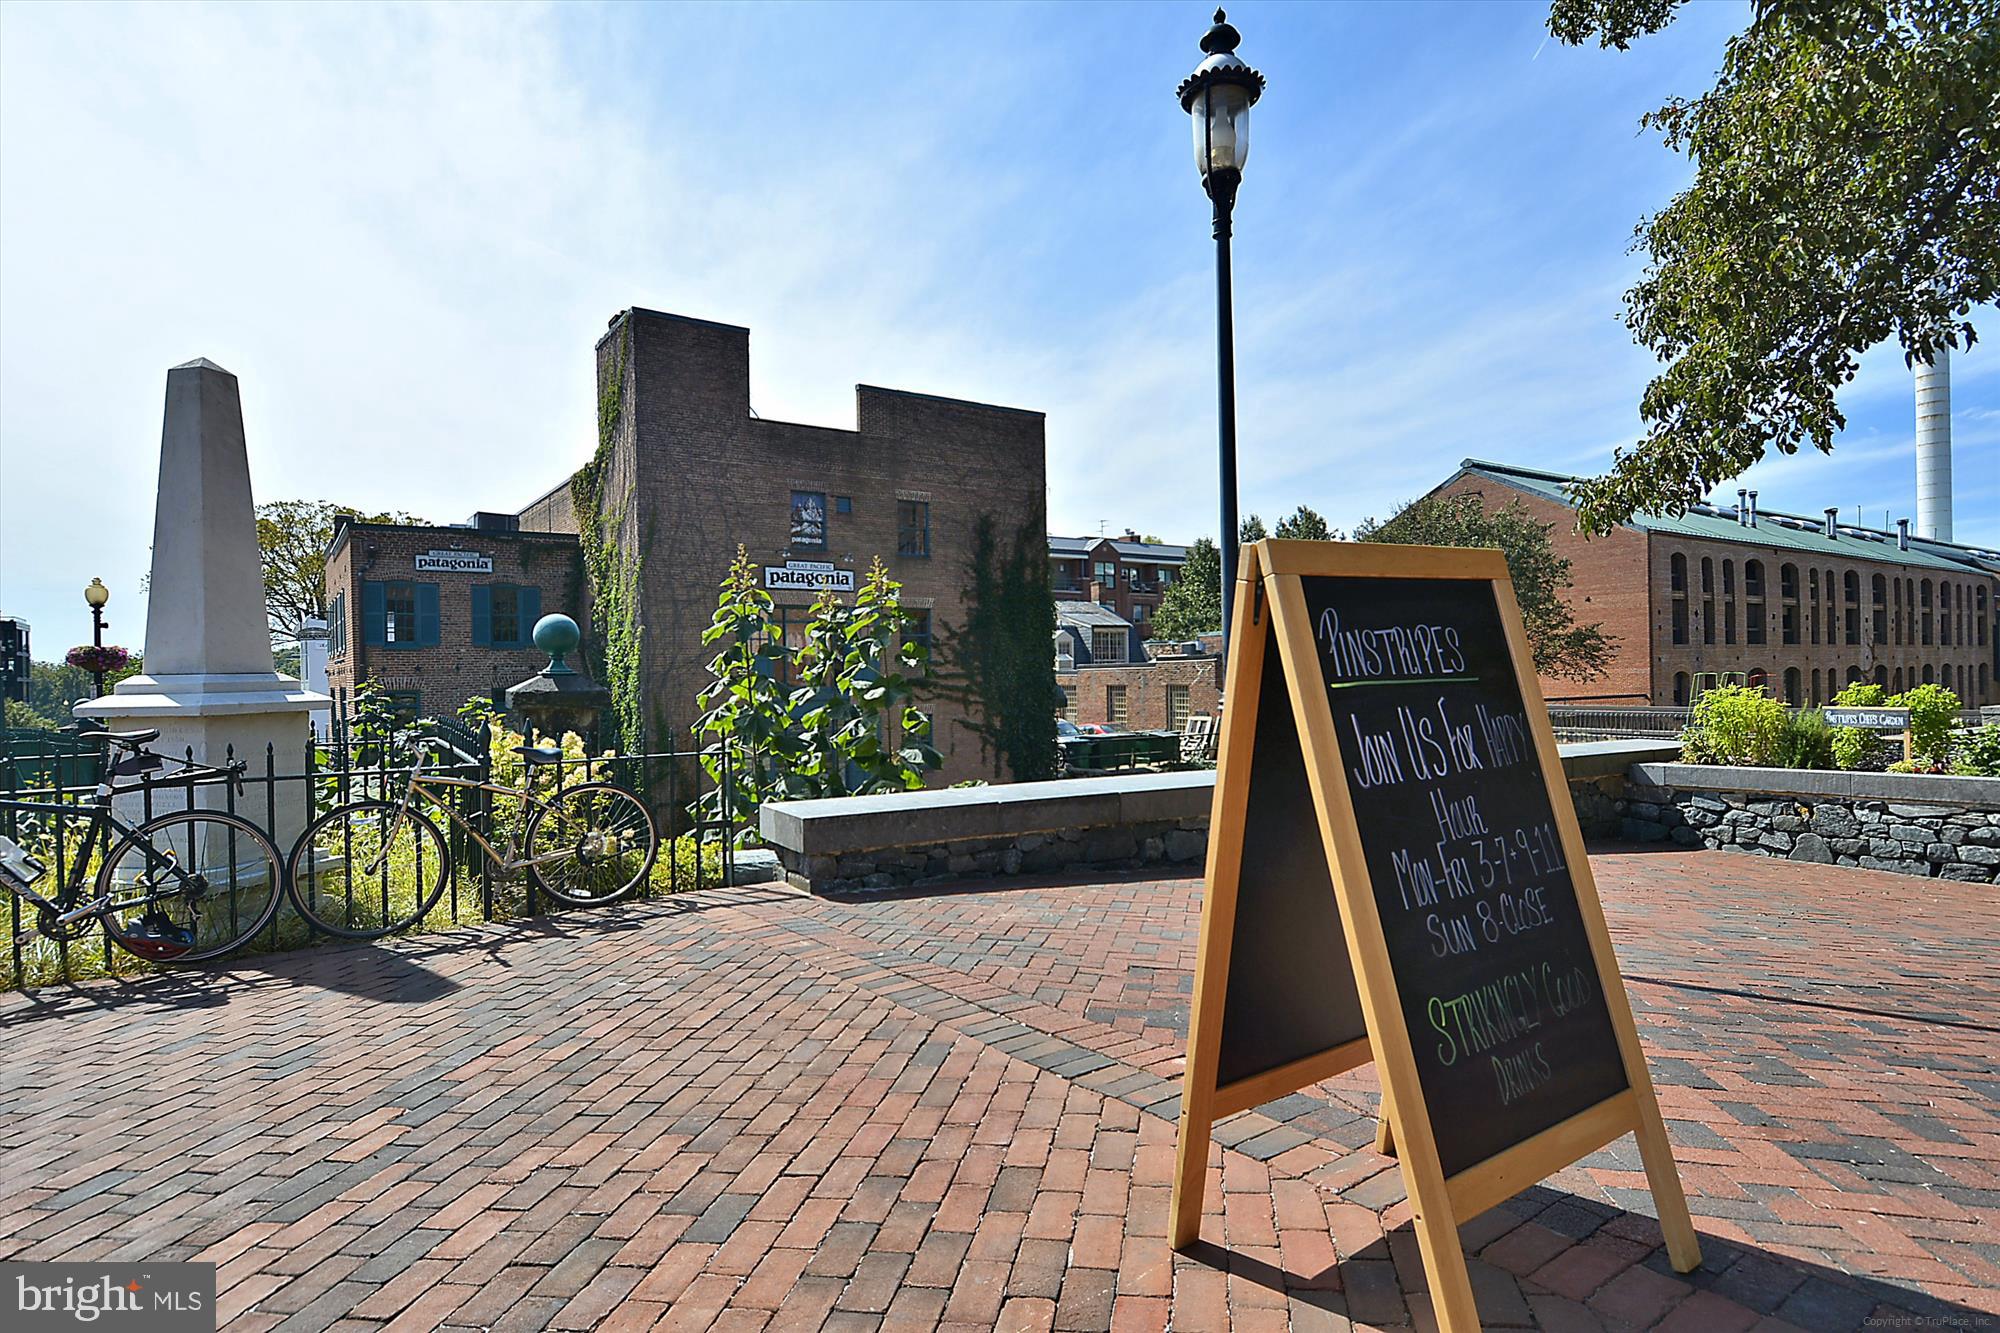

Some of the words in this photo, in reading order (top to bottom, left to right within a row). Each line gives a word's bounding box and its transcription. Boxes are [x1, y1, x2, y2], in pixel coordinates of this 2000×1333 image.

[418, 558, 488, 570] patagonia
[769, 570, 850, 587] patagonia
[1319, 607, 1467, 678] PINSTRIPES
[1350, 713, 1404, 789] JOIN
[1397, 706, 1447, 781] US
[1437, 697, 1484, 774] FOR
[1475, 704, 1529, 769] HAPPY
[1429, 788, 1489, 846] HOUR
[1427, 912, 1478, 959] SUN
[1427, 965, 1541, 1067] STRIKINGLY
[1541, 961, 1592, 1018] GOOD
[1490, 1041, 1553, 1106] DRINKS
